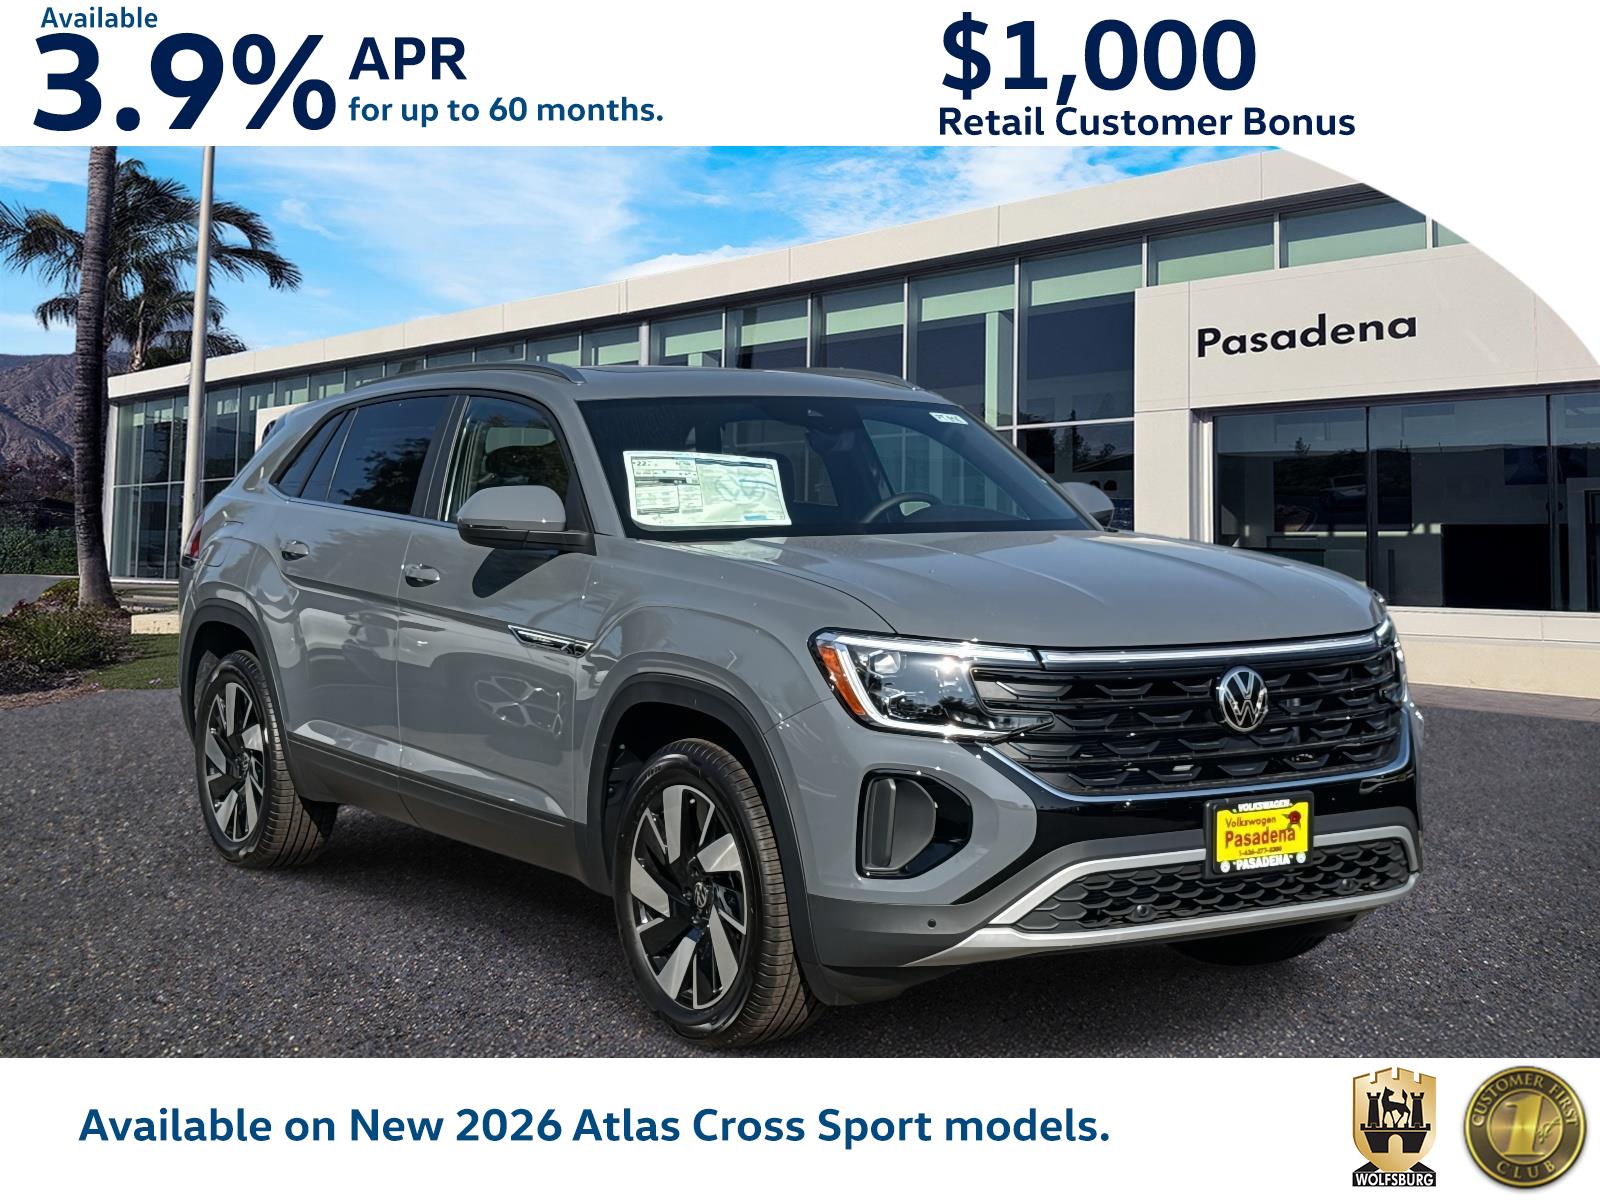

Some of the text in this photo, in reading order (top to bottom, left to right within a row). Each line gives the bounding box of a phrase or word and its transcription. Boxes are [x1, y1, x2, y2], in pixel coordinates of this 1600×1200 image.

[1198, 313, 1416, 357] Pasadena
[1238, 799, 1291, 812] VOLKSWAGEN
[1225, 817, 1276, 828] Volkswagen
[1225, 827, 1296, 848] Pasadena
[1236, 854, 1291, 870] PASADENA
